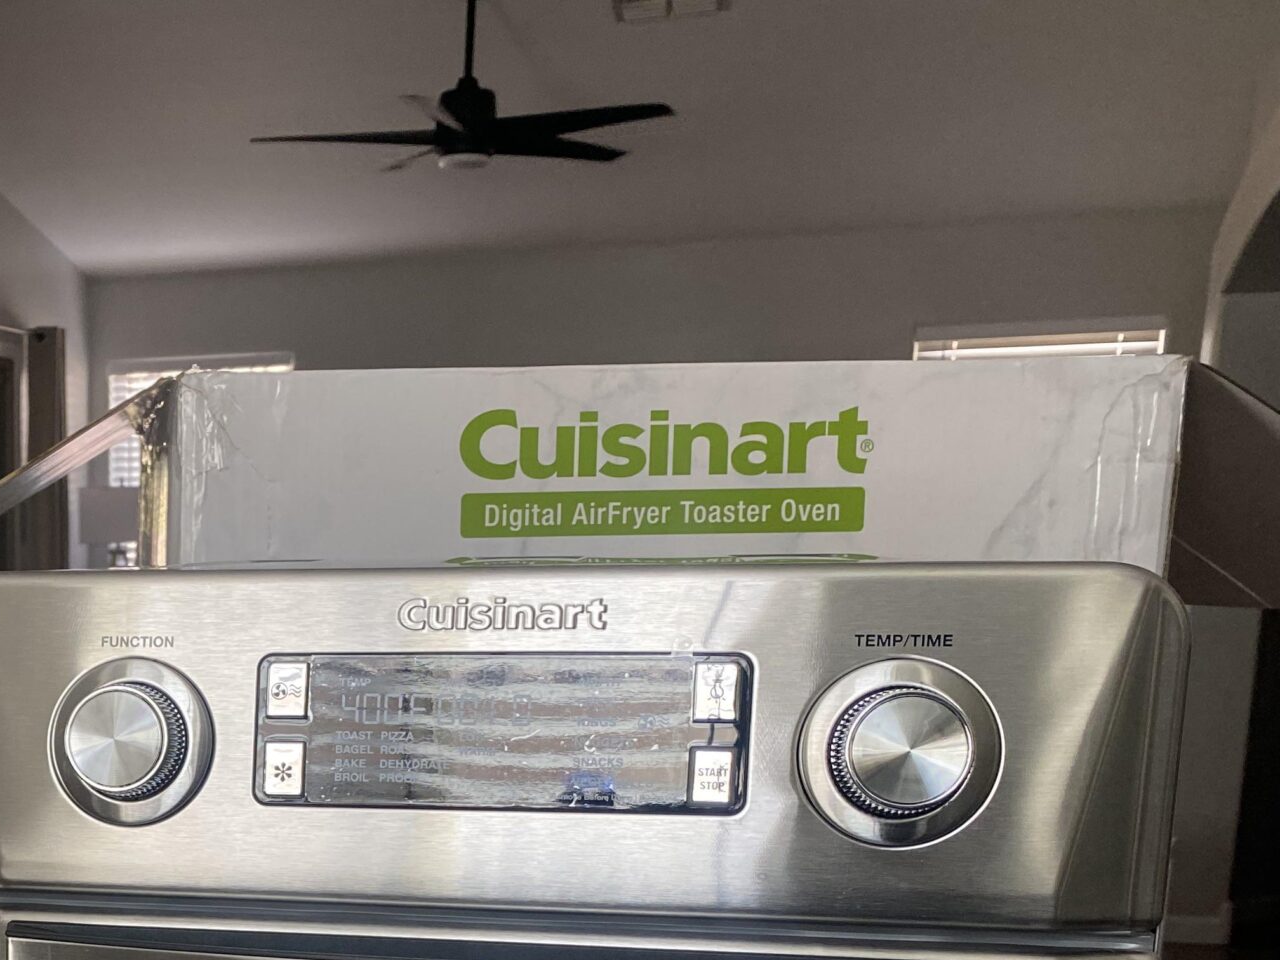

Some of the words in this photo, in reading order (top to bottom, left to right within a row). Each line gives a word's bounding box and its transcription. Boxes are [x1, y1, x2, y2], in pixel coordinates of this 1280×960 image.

[484, 503, 562, 531] Digital
[571, 502, 671, 529] AirFryer
[680, 500, 771, 524] Toaster
[780, 499, 841, 522] Oven
[398, 597, 608, 631] Cuisinart
[101, 636, 174, 648] FUNCTION
[854, 634, 953, 647] TEMP/TIME
[336, 731, 374, 741] TOAST
[380, 731, 414, 742] PIZZA
[335, 745, 374, 755] BAGEL
[334, 759, 367, 769] BAKE
[334, 772, 369, 783] BROIL
[698, 767, 728, 777] START
[699, 781, 725, 790] STOP
